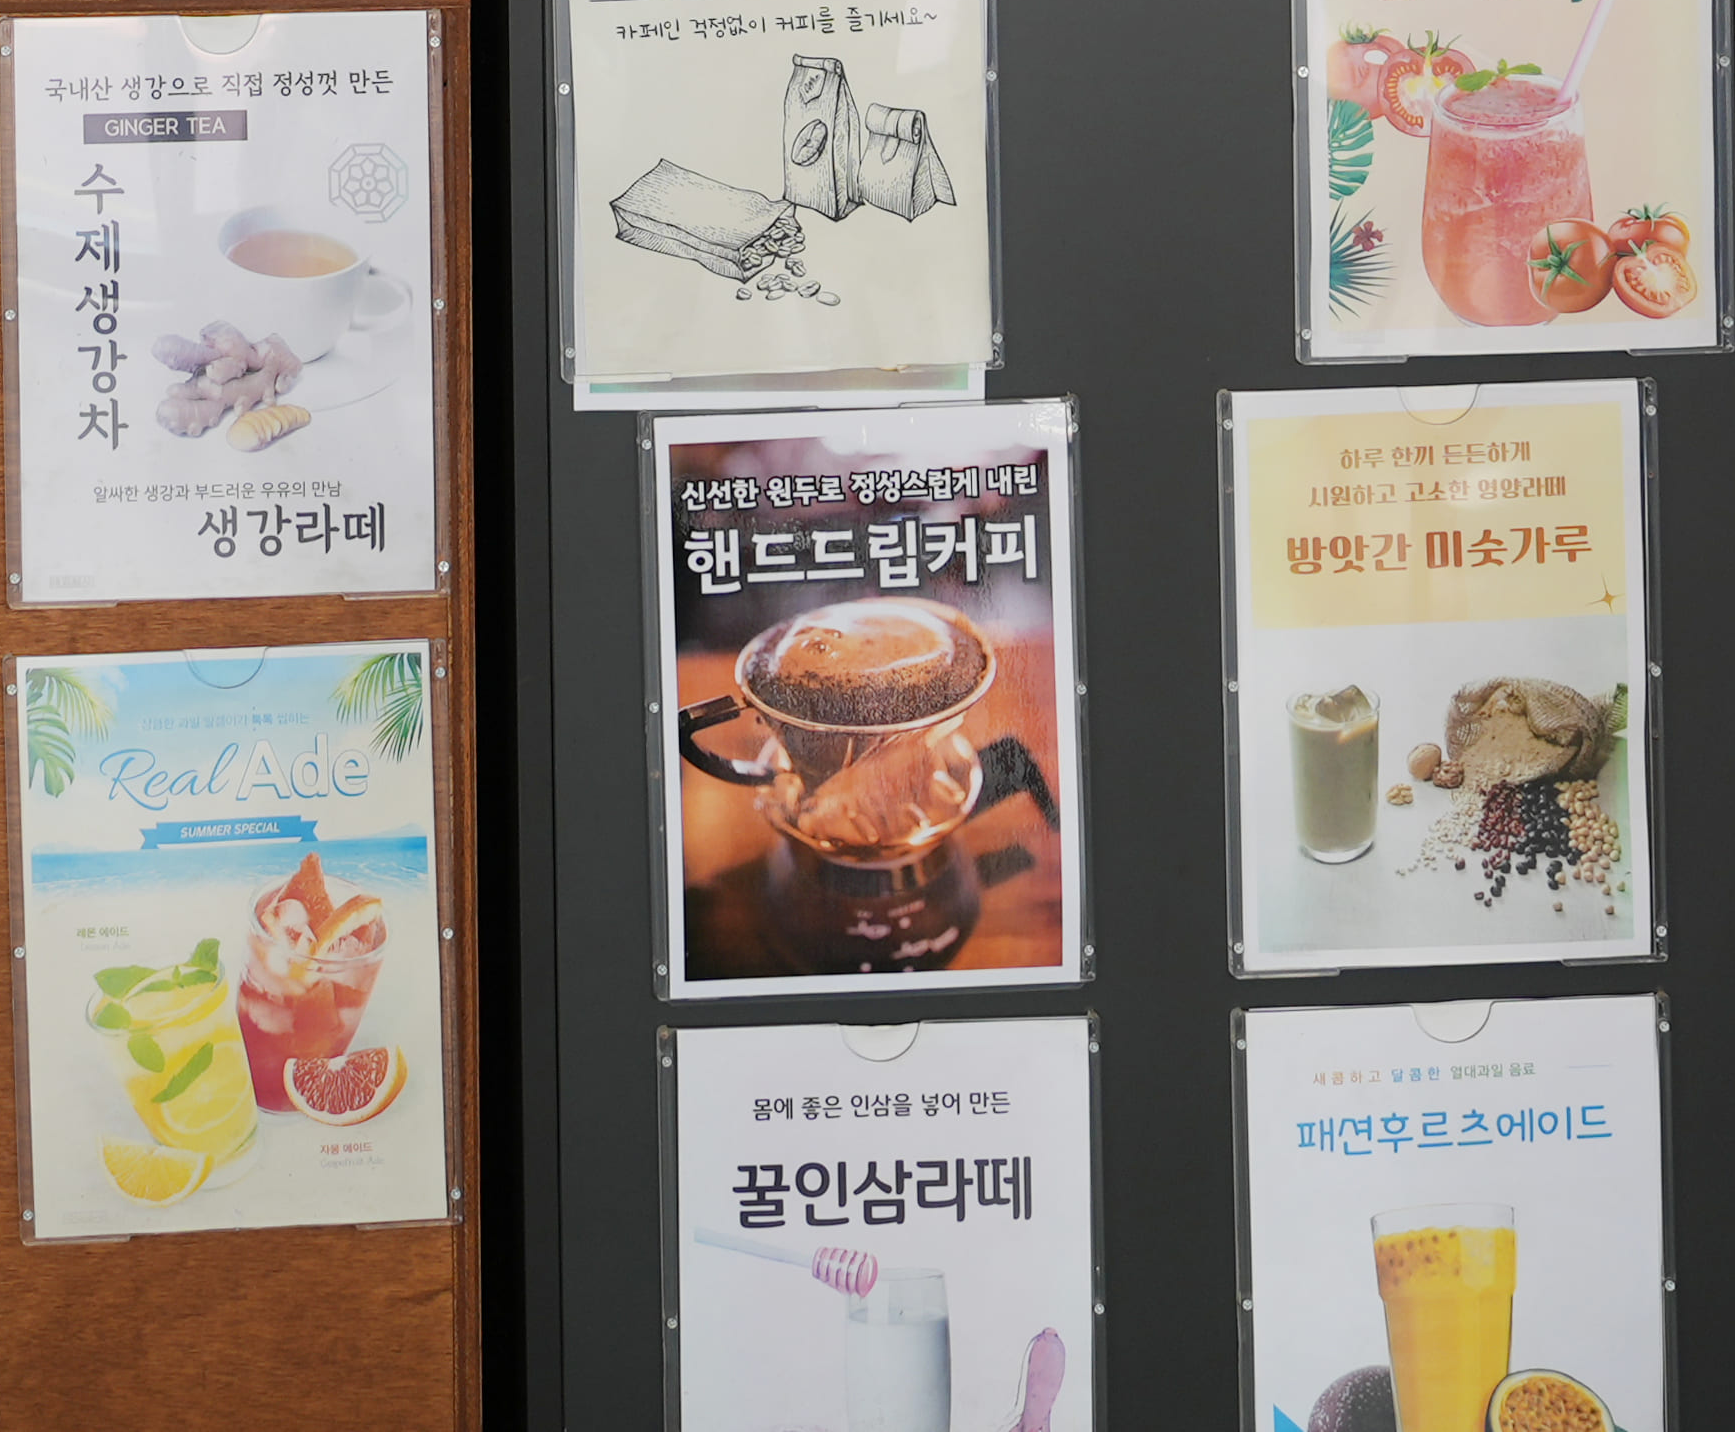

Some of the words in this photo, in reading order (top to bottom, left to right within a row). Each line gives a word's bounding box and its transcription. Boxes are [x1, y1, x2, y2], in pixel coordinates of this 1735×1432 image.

[104, 118, 179, 137] GINGER
[186, 117, 226, 135] TEA
[144, 482, 190, 501] 생강과
[195, 482, 256, 501] 부드러운
[260, 481, 307, 499] 우유의
[311, 480, 342, 499] 만남
[681, 477, 760, 511] 신선한
[766, 474, 844, 509] 원두로
[850, 468, 979, 505] 정성스럽게
[985, 464, 1038, 497] 내린
[197, 502, 386, 558] 생강라떼
[684, 514, 1038, 596] 핸드드립커피
[1286, 533, 1411, 576] 방앗간
[1425, 524, 1593, 570] 미숫가루
[99, 742, 241, 811] Real
[236, 732, 370, 802] Ade
[180, 823, 231, 838] SUMMER
[234, 820, 280, 835] SPECIAL
[1296, 1105, 1612, 1156] 패션후르츠에이드
[731, 1157, 1032, 1228] 꿀인삼라떼
